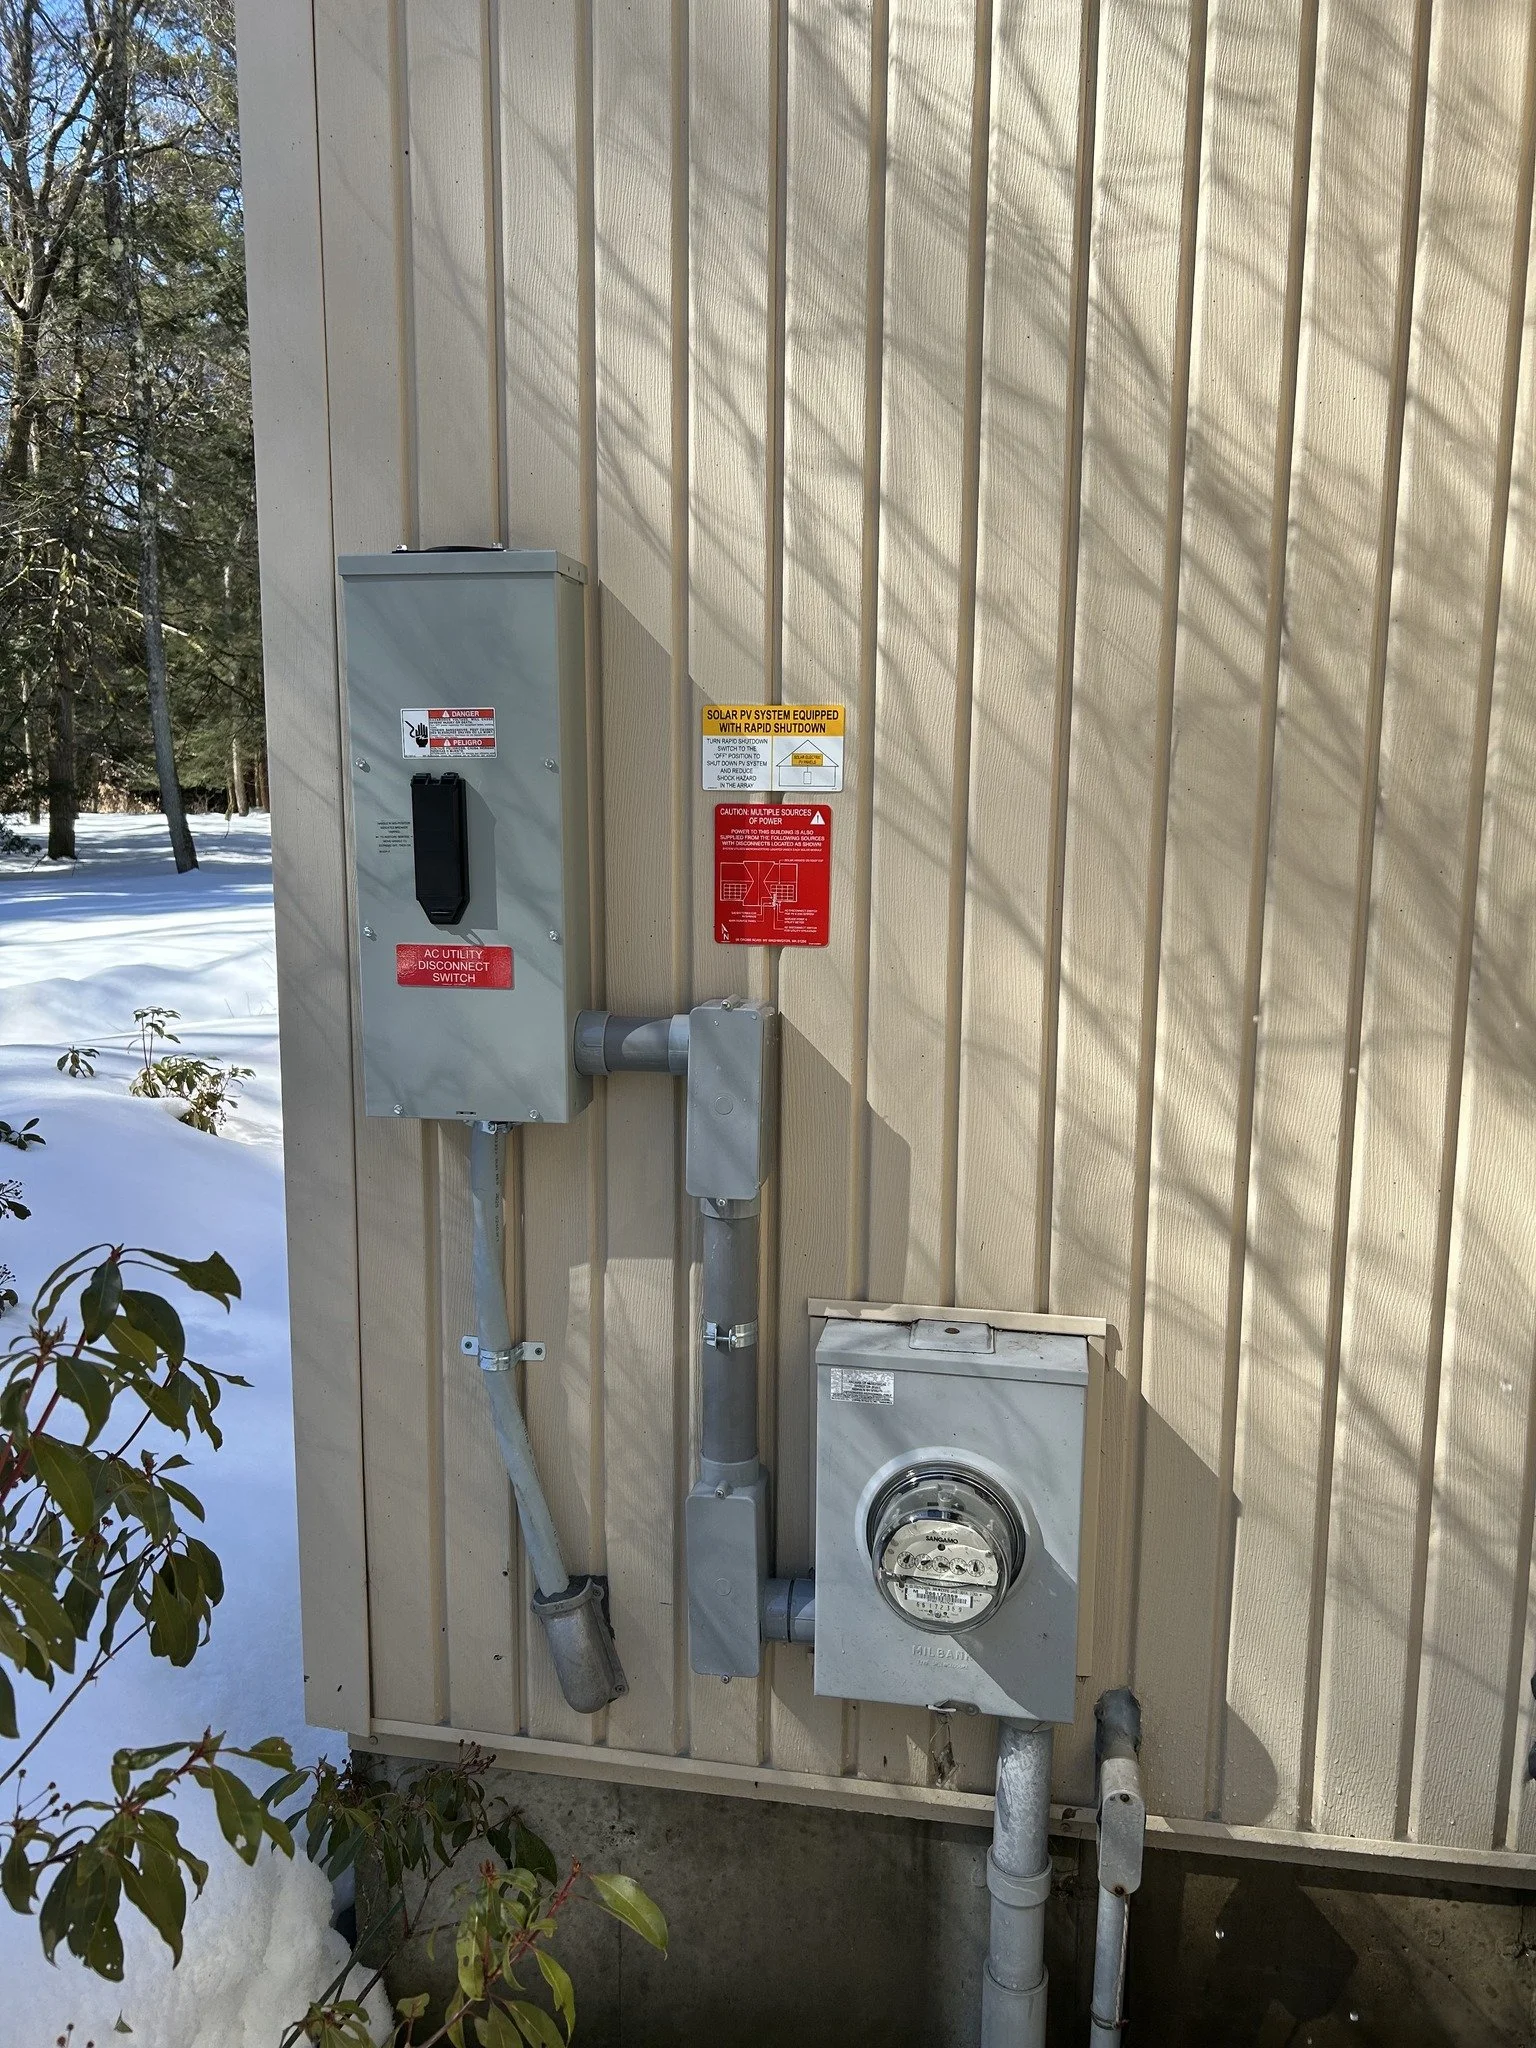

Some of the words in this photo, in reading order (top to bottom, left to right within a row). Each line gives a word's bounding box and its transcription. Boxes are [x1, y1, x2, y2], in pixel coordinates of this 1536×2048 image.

[707, 710, 738, 720] SOLAR
[740, 710, 752, 720] PV
[754, 710, 790, 720] SYSTEM
[794, 710, 839, 721] EQUIPPED
[719, 723, 742, 733] WITH
[744, 723, 772, 733] RAPID
[774, 723, 826, 733] SHUTDOWN
[720, 808, 749, 816] CAUTION:
[750, 808, 779, 816] MULTIPLE
[781, 809, 812, 817] SOURCES
[748, 817, 758, 825] OF
[759, 817, 782, 825] POWER
[424, 949, 440, 958] AC
[442, 949, 484, 959] UTILITY
[418, 960, 490, 971] DISCONNECT
[432, 973, 476, 983] SWITCH
[926, 1535, 958, 1544] SANGAMO
